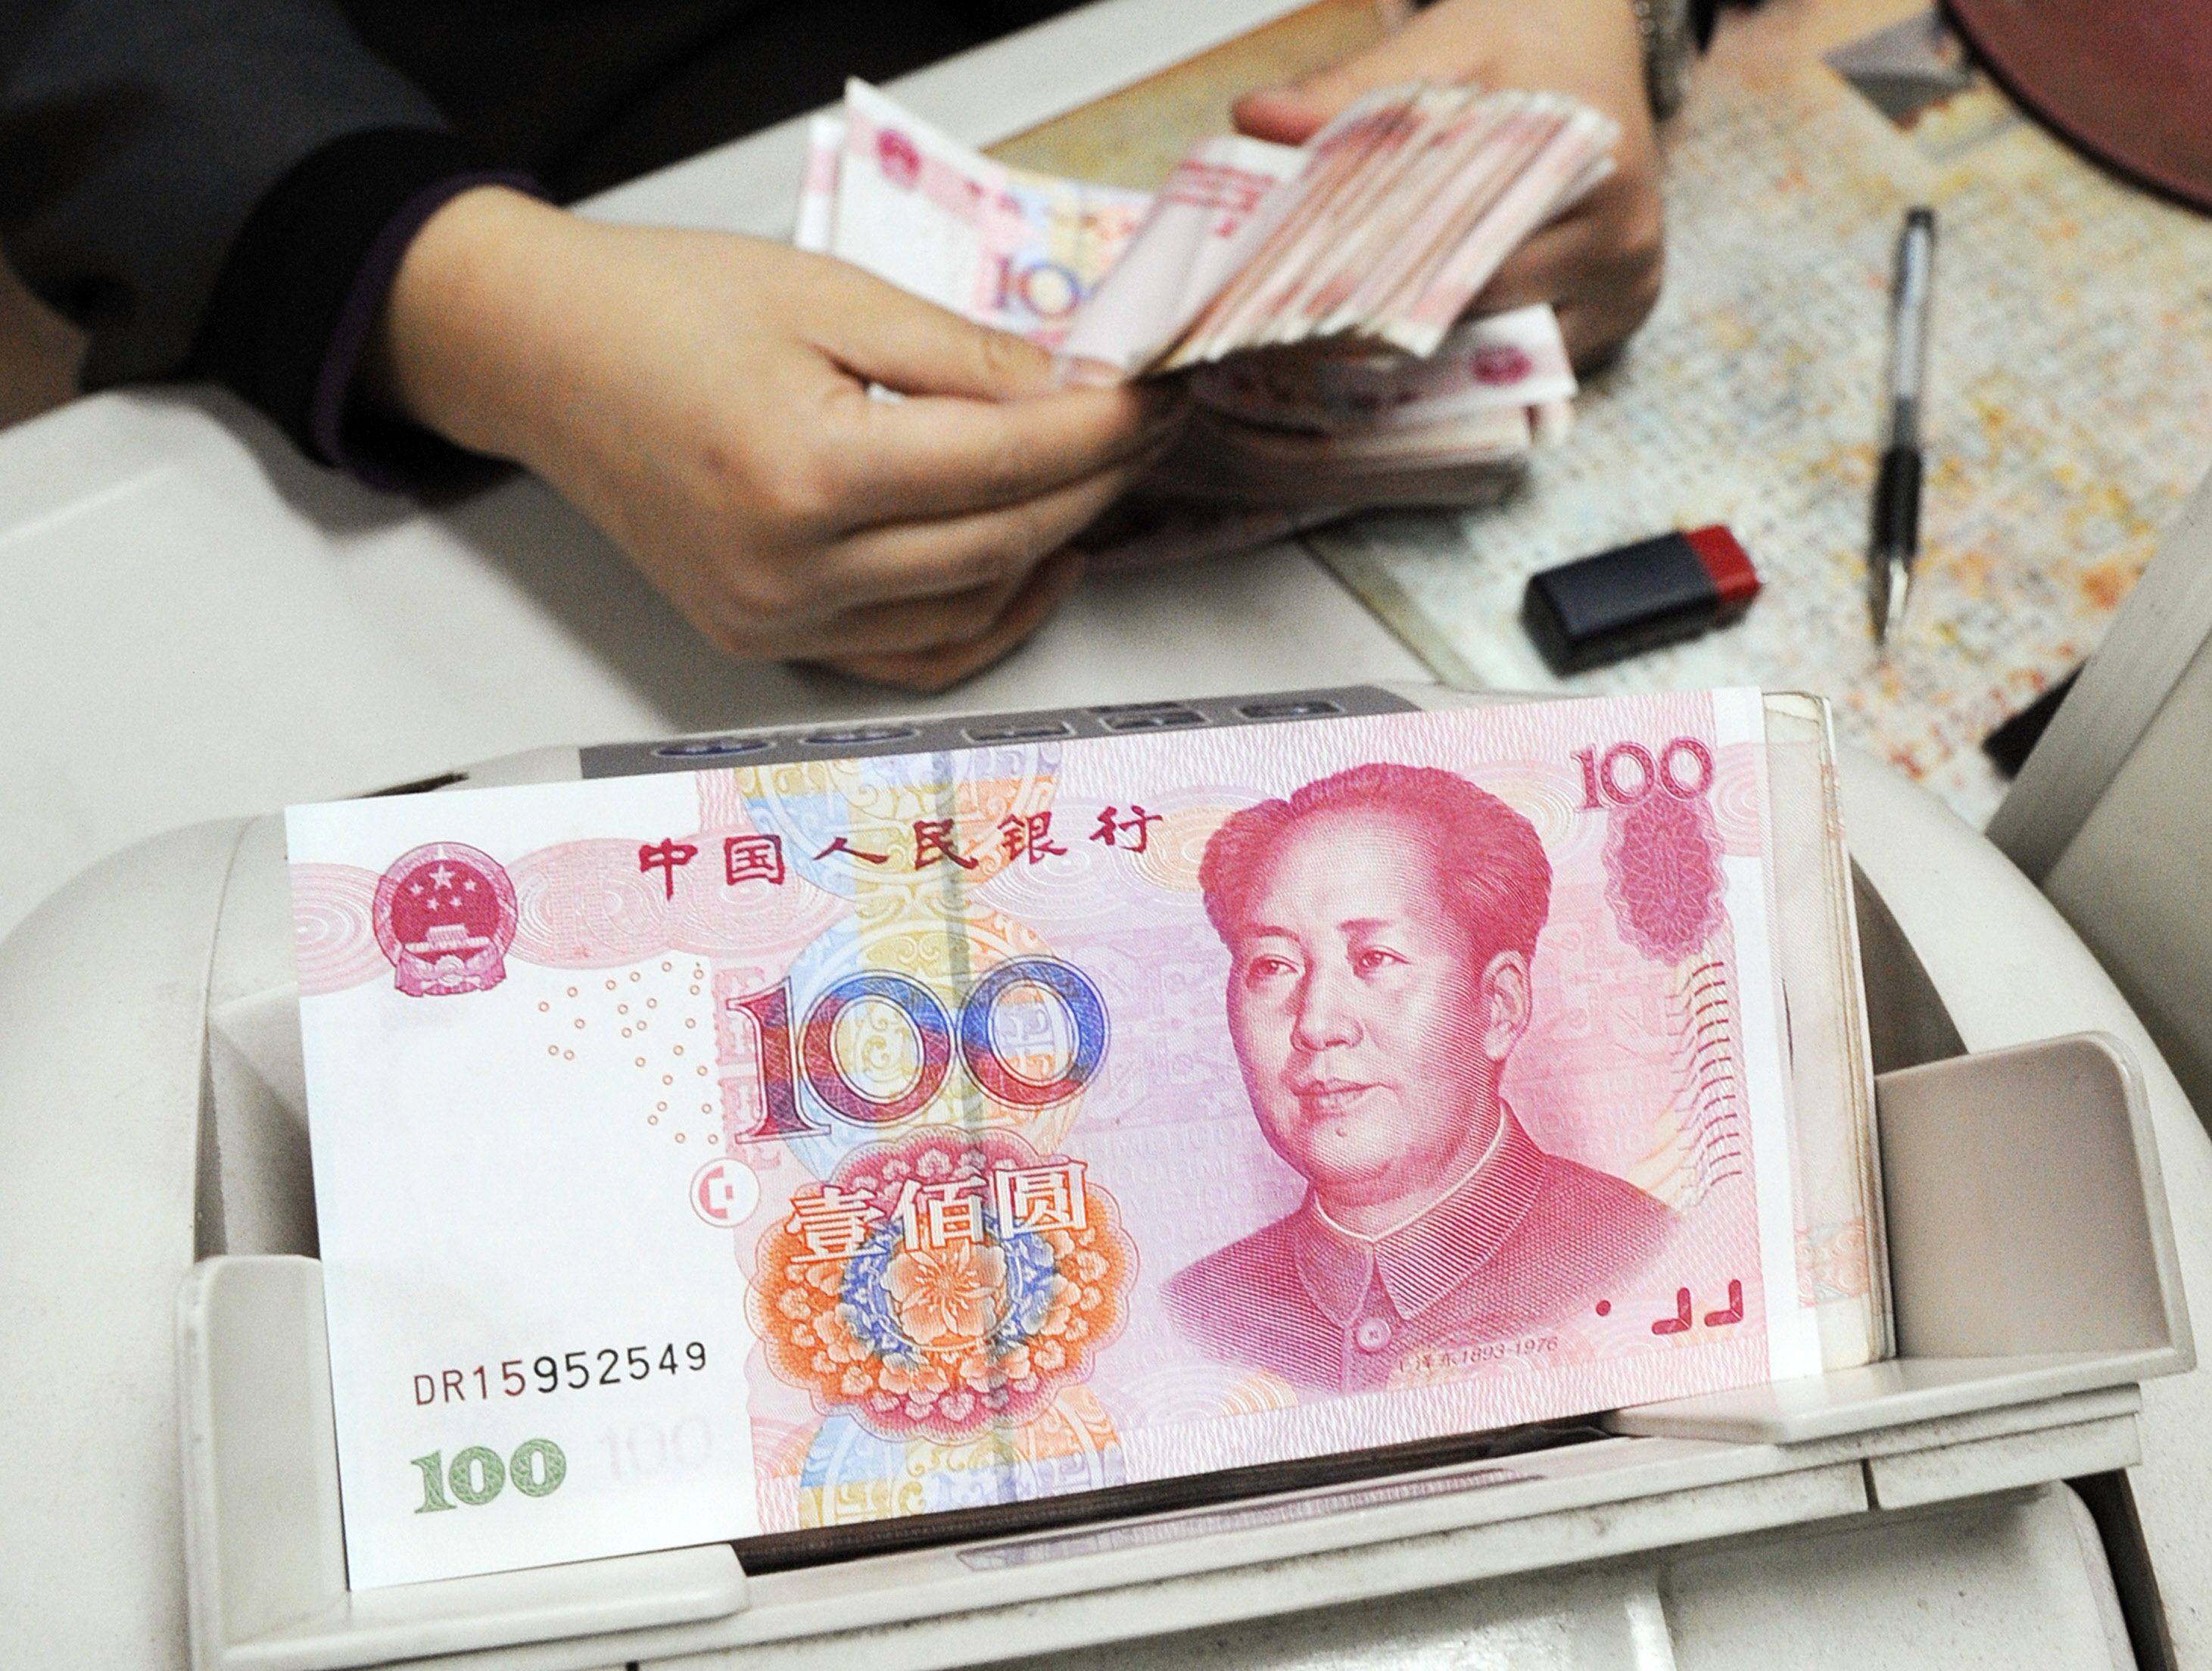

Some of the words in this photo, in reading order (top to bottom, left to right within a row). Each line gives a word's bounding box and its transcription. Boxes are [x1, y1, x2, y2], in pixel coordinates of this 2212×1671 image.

[1570, 737, 1713, 813] 100
[639, 804, 1164, 901] 中国人民银行
[726, 953, 1111, 1145] 100
[784, 1154, 1089, 1264] 壹佰圆
[413, 1341, 707, 1406] DR15952549
[1461, 1336, 1559, 1364] 1893-1976
[410, 1438, 568, 1514] 100
